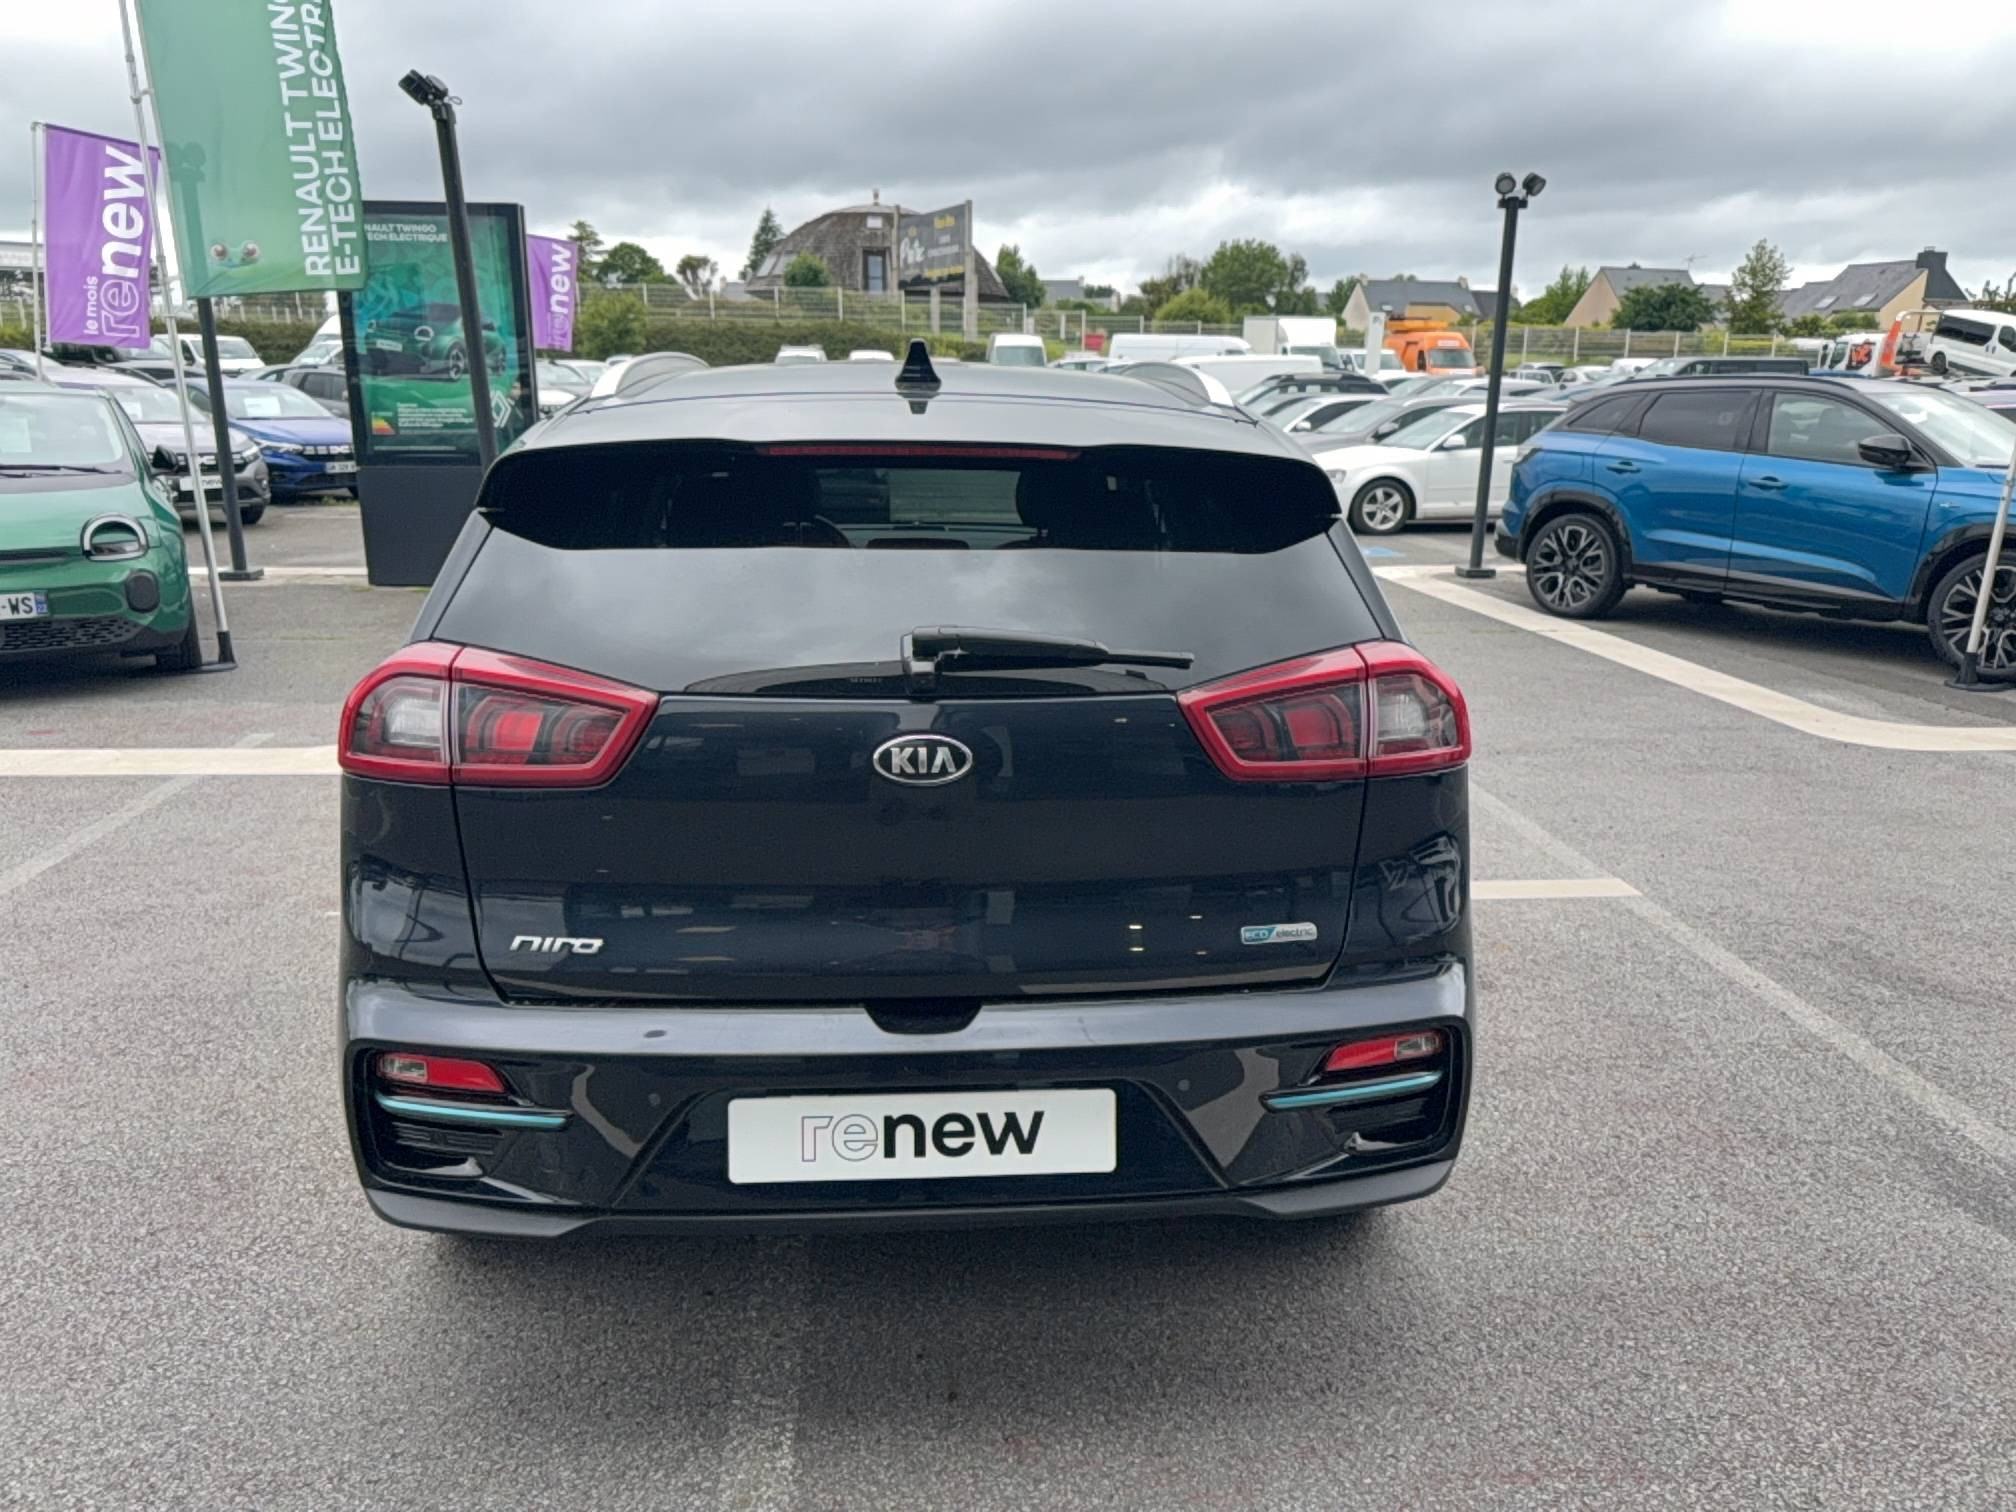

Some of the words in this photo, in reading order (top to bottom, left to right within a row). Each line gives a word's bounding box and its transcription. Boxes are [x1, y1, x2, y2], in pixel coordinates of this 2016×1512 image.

[267, 0, 308, 106] TWIN
[300, 0, 343, 141] ELECTR
[100, 144, 145, 338] renew
[284, 112, 332, 275] RENAULT
[321, 150, 360, 275] E-TECH
[363, 223, 396, 232] NAULT
[396, 223, 437, 233] TWINGO
[83, 276, 99, 316] mois
[890, 746, 956, 773] KIA
[801, 1110, 1045, 1162] renew
